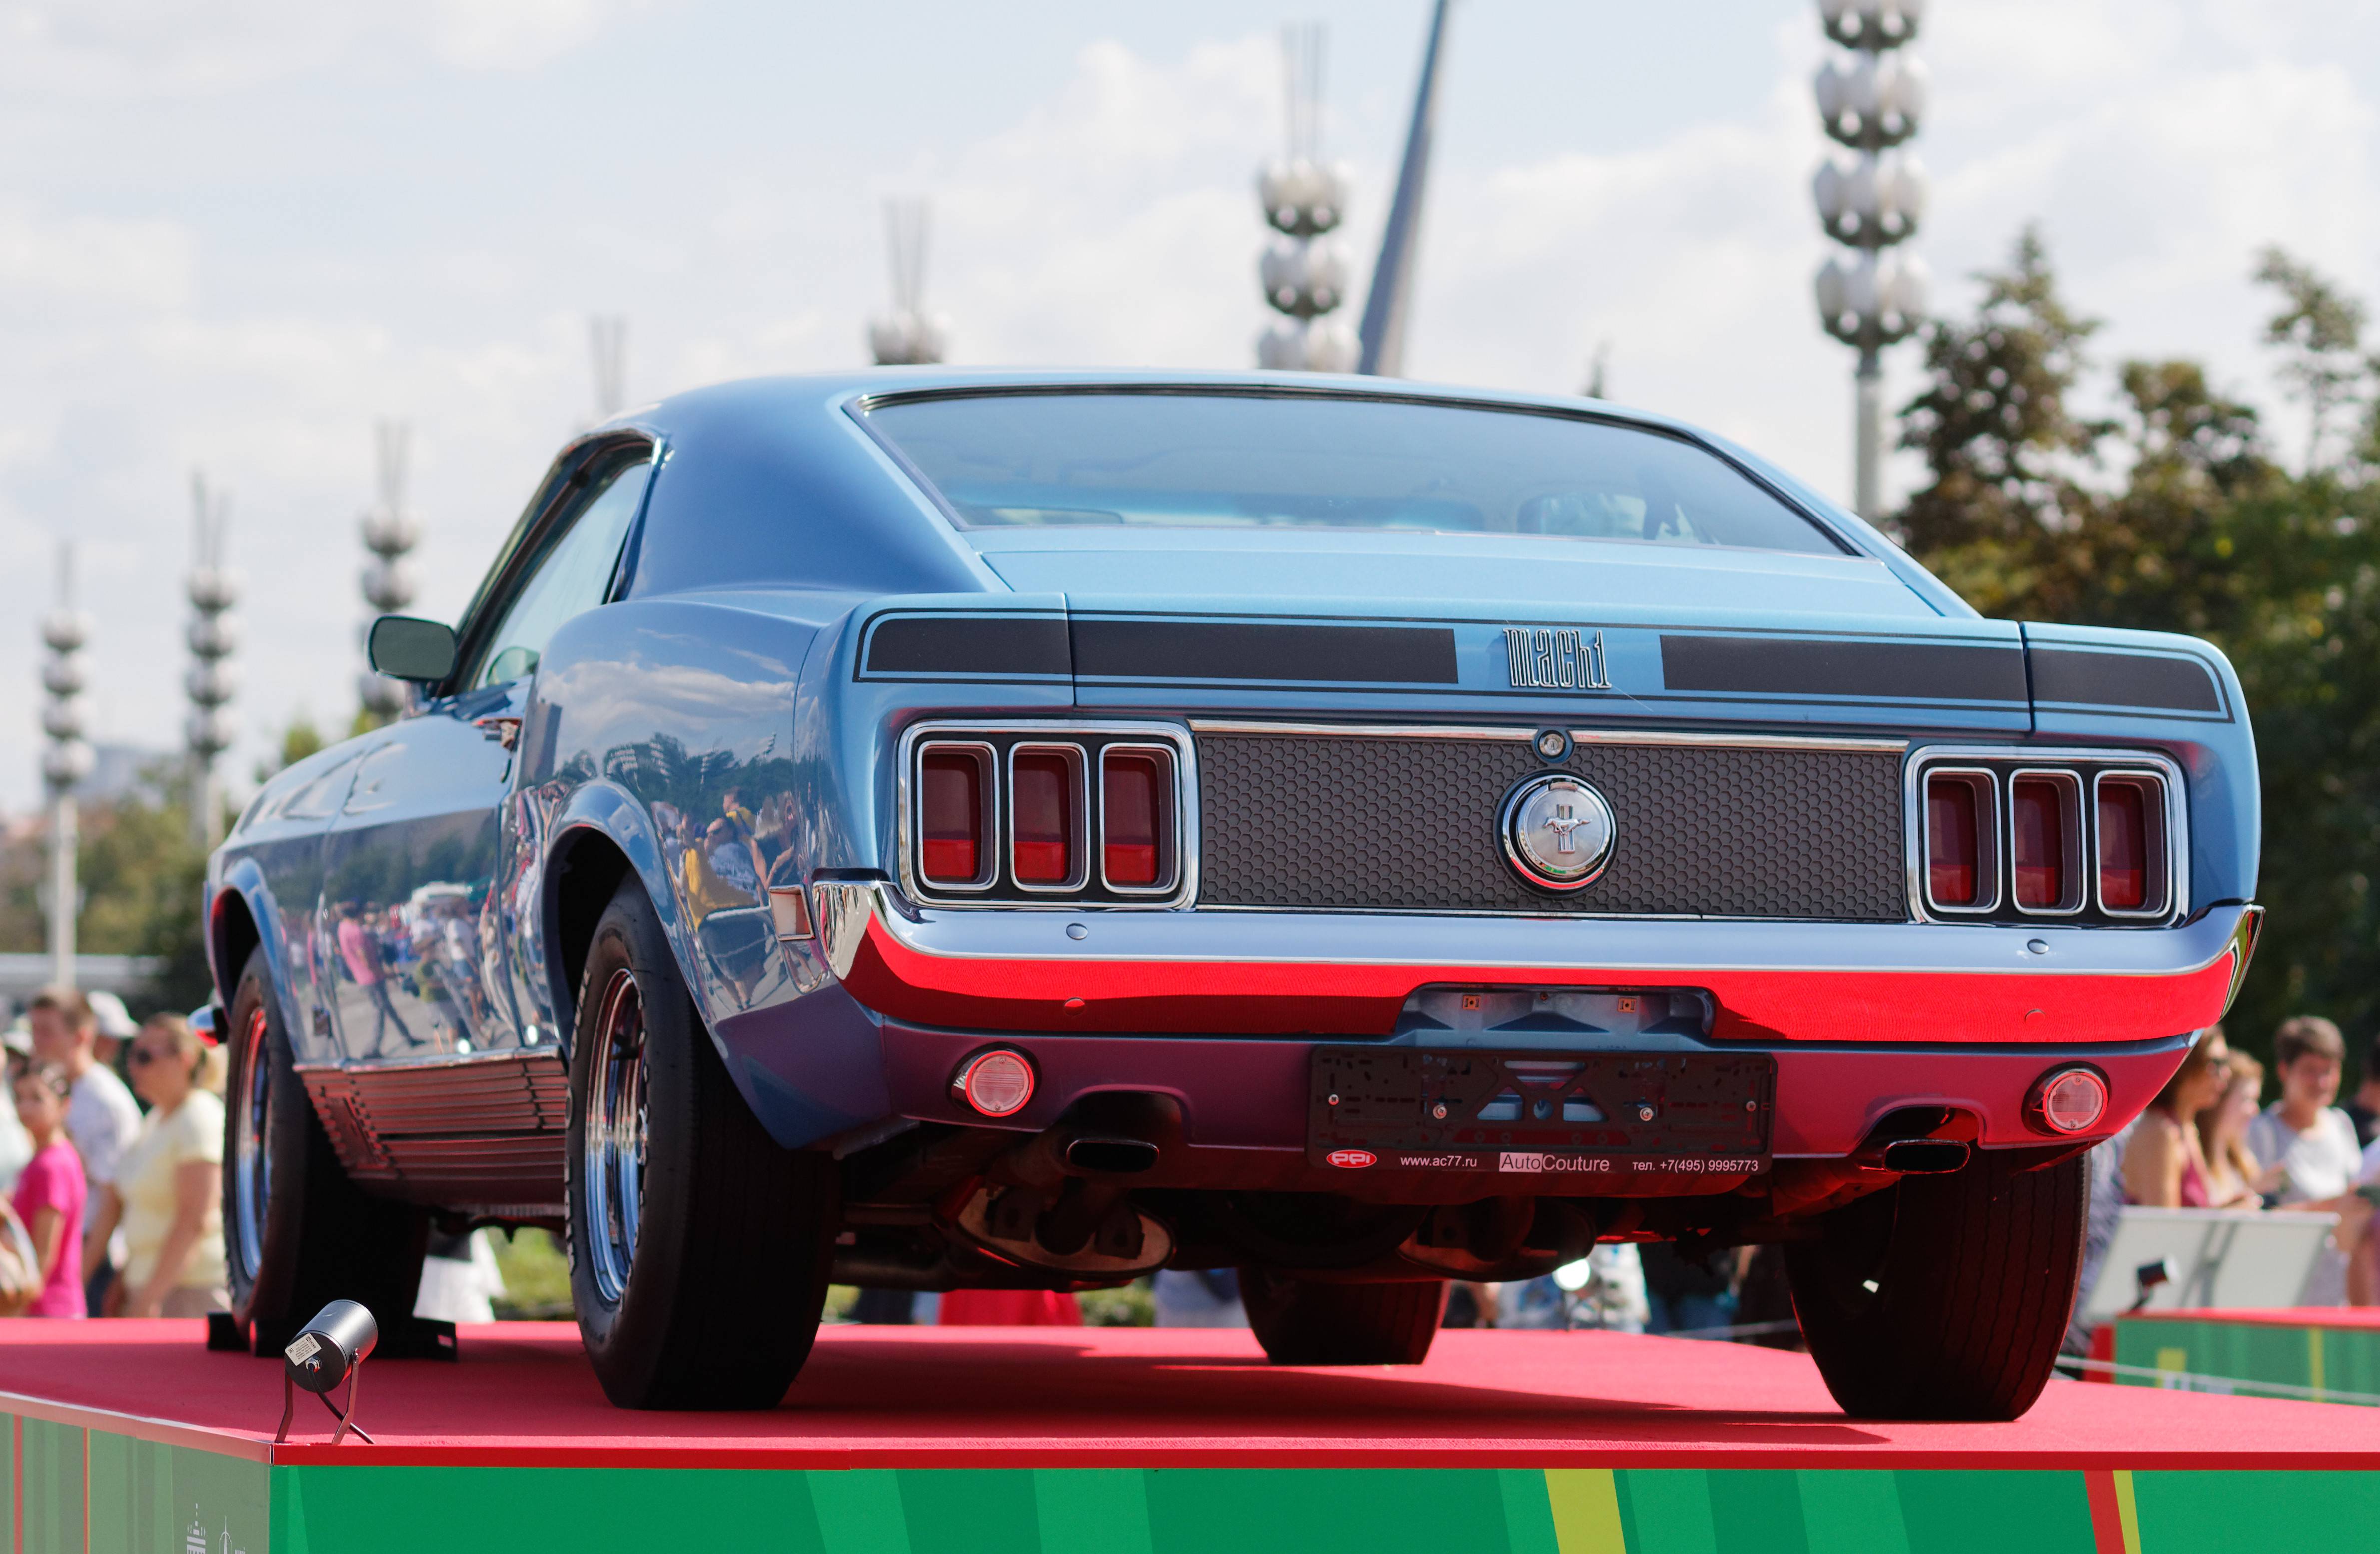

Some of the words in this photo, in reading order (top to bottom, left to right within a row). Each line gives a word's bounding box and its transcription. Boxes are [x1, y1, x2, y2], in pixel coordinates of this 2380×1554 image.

[1400, 1155, 1477, 1167] www.ac77.ru
[1501, 1154, 1610, 1171] AutoCouture
[1632, 1161, 1655, 1171] тел.
[1660, 1159, 1705, 1173] +7(495)
[1708, 1160, 1759, 1171] 9995773
